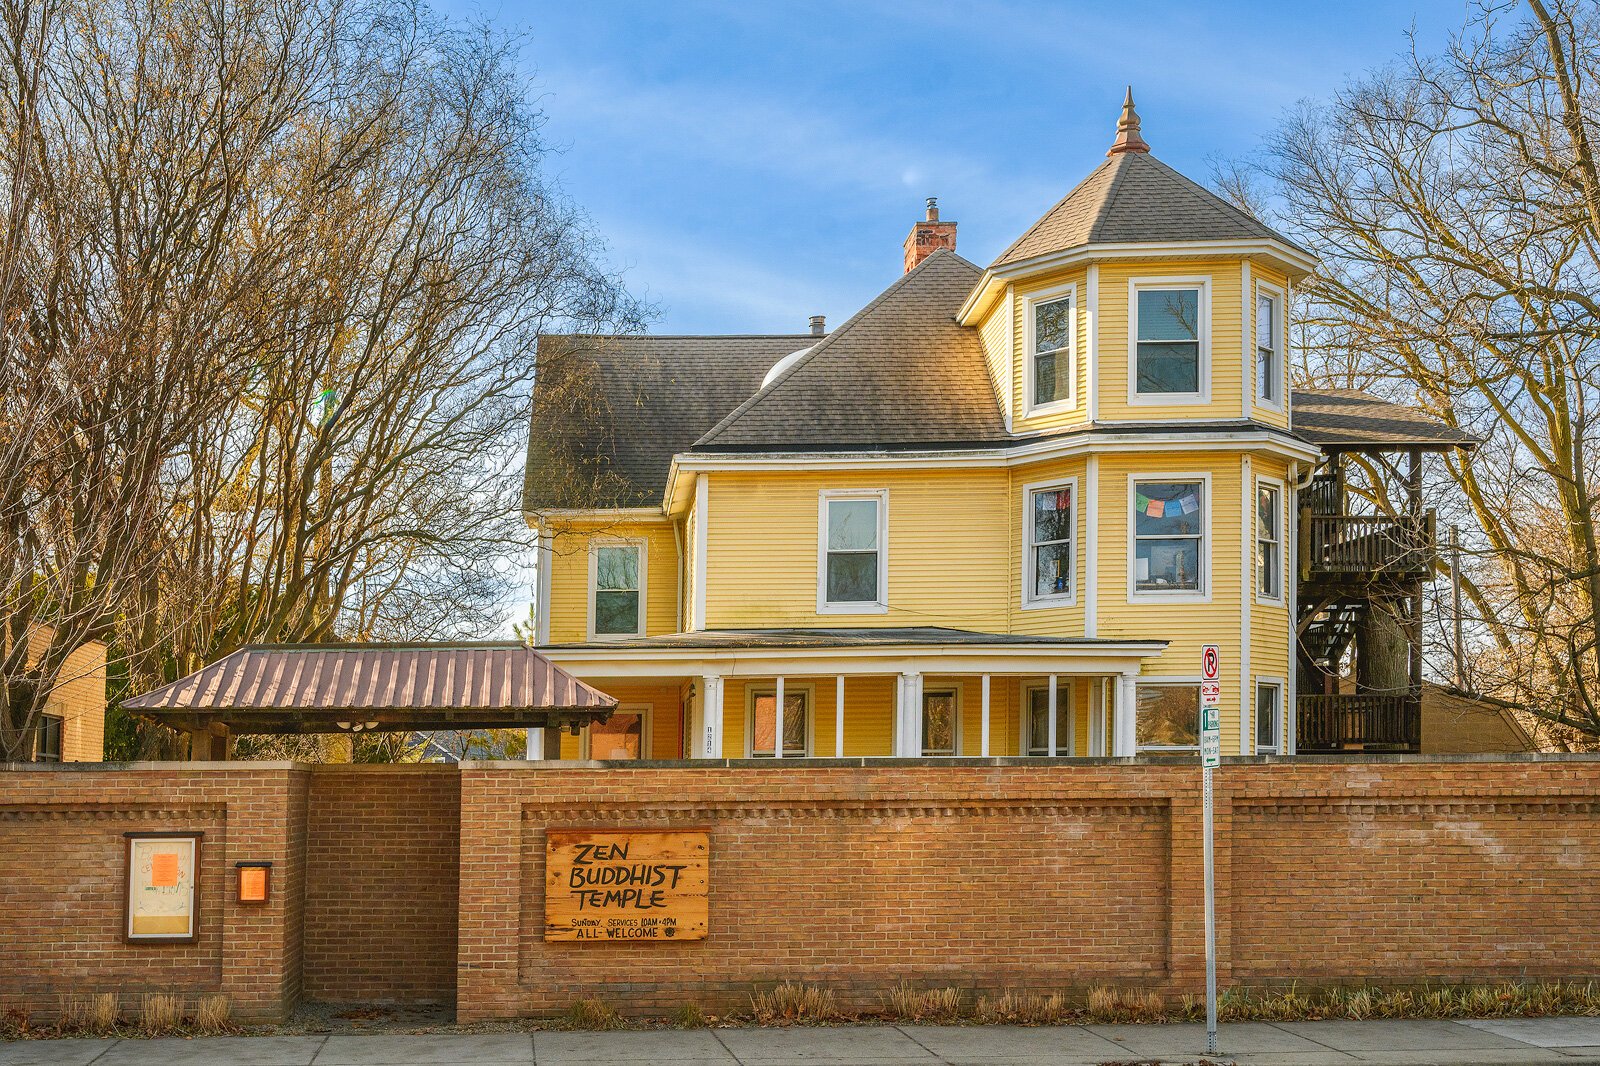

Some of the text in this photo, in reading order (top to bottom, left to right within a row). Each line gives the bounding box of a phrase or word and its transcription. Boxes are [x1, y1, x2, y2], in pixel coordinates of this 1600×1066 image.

[573, 842, 629, 865] ZEN
[569, 864, 688, 889] BUDDHIST
[570, 888, 668, 911] TEMPLE
[606, 927, 658, 938] WELCOME
[607, 918, 638, 927] SERVICES
